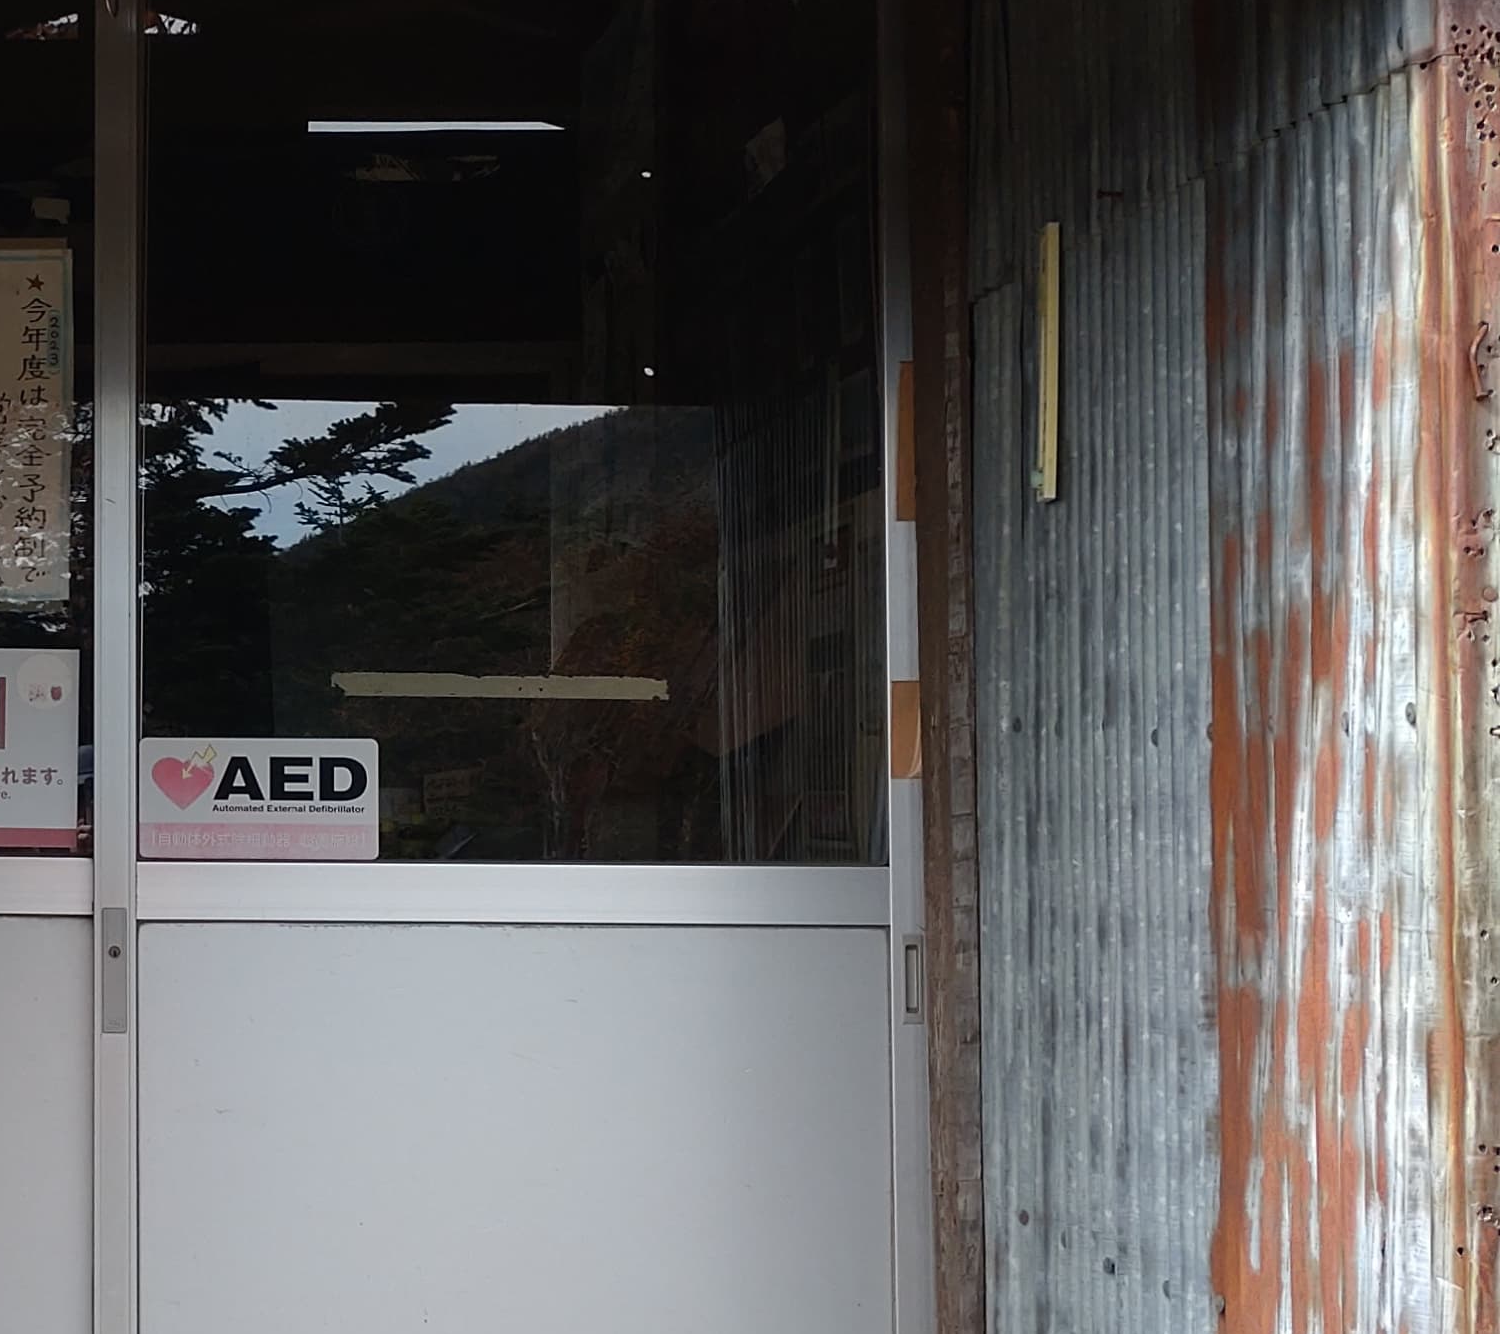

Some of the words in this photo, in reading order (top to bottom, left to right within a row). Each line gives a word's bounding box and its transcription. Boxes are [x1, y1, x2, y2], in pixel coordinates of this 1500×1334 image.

[213, 755, 368, 802] AED
[212, 803, 264, 813] Automated
[267, 803, 306, 813] External
[308, 804, 365, 814] Defibrillator
